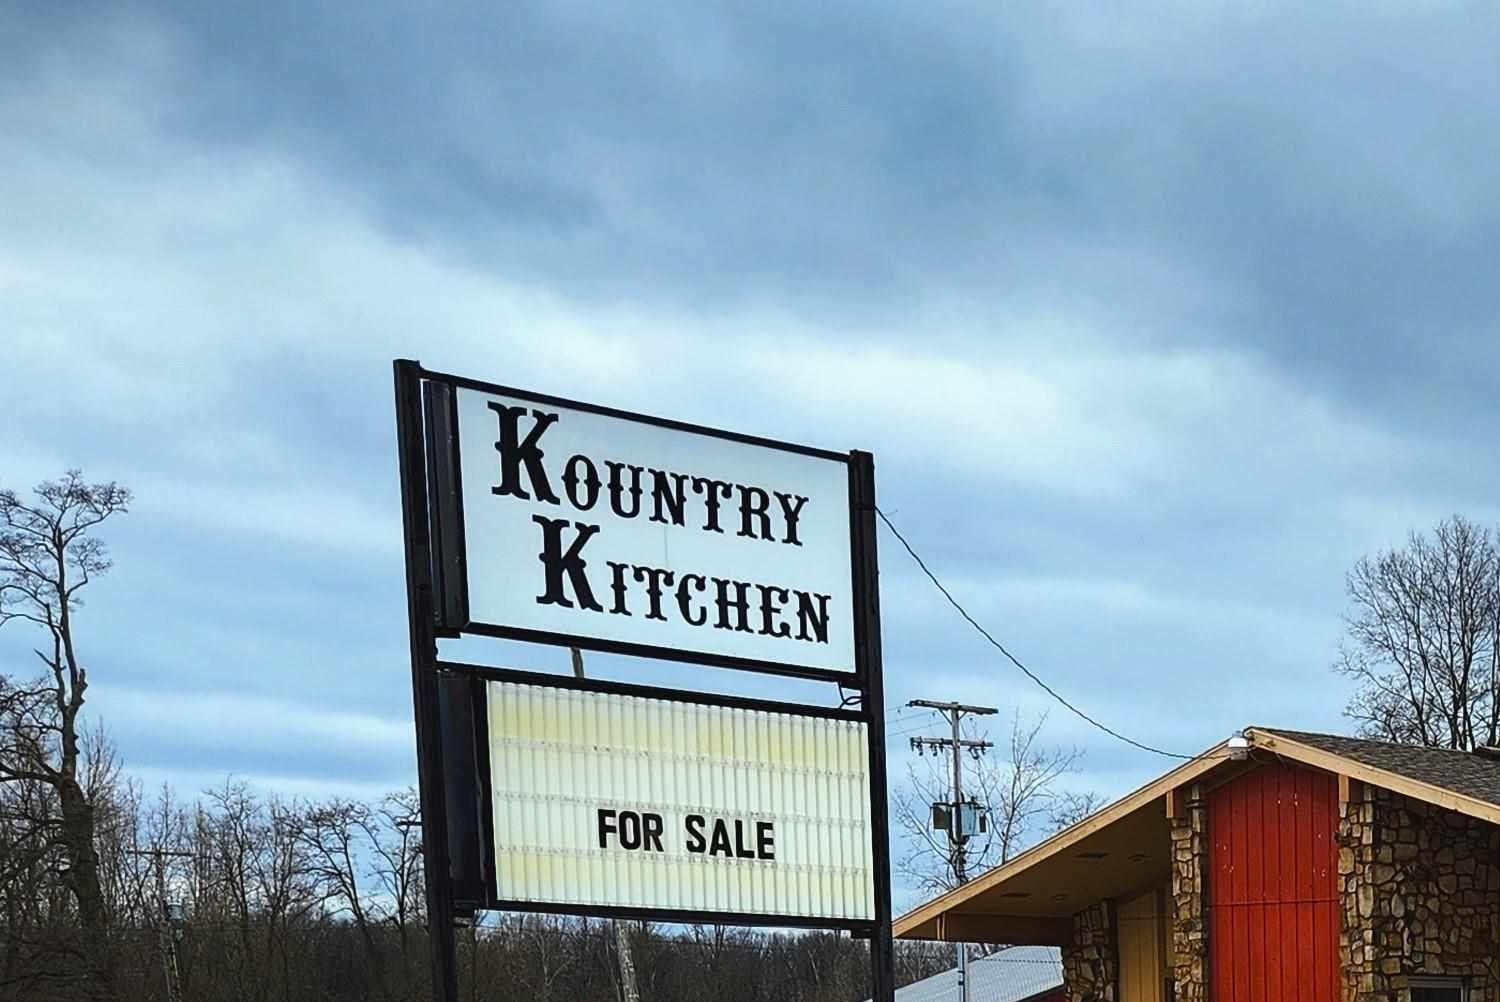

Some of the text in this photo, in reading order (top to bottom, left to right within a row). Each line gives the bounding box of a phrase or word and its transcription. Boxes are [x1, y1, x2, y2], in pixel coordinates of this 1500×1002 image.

[487, 400, 809, 546] KOUNTRY
[532, 514, 832, 644] KITCHEN
[597, 808, 776, 860] FOR SALE
